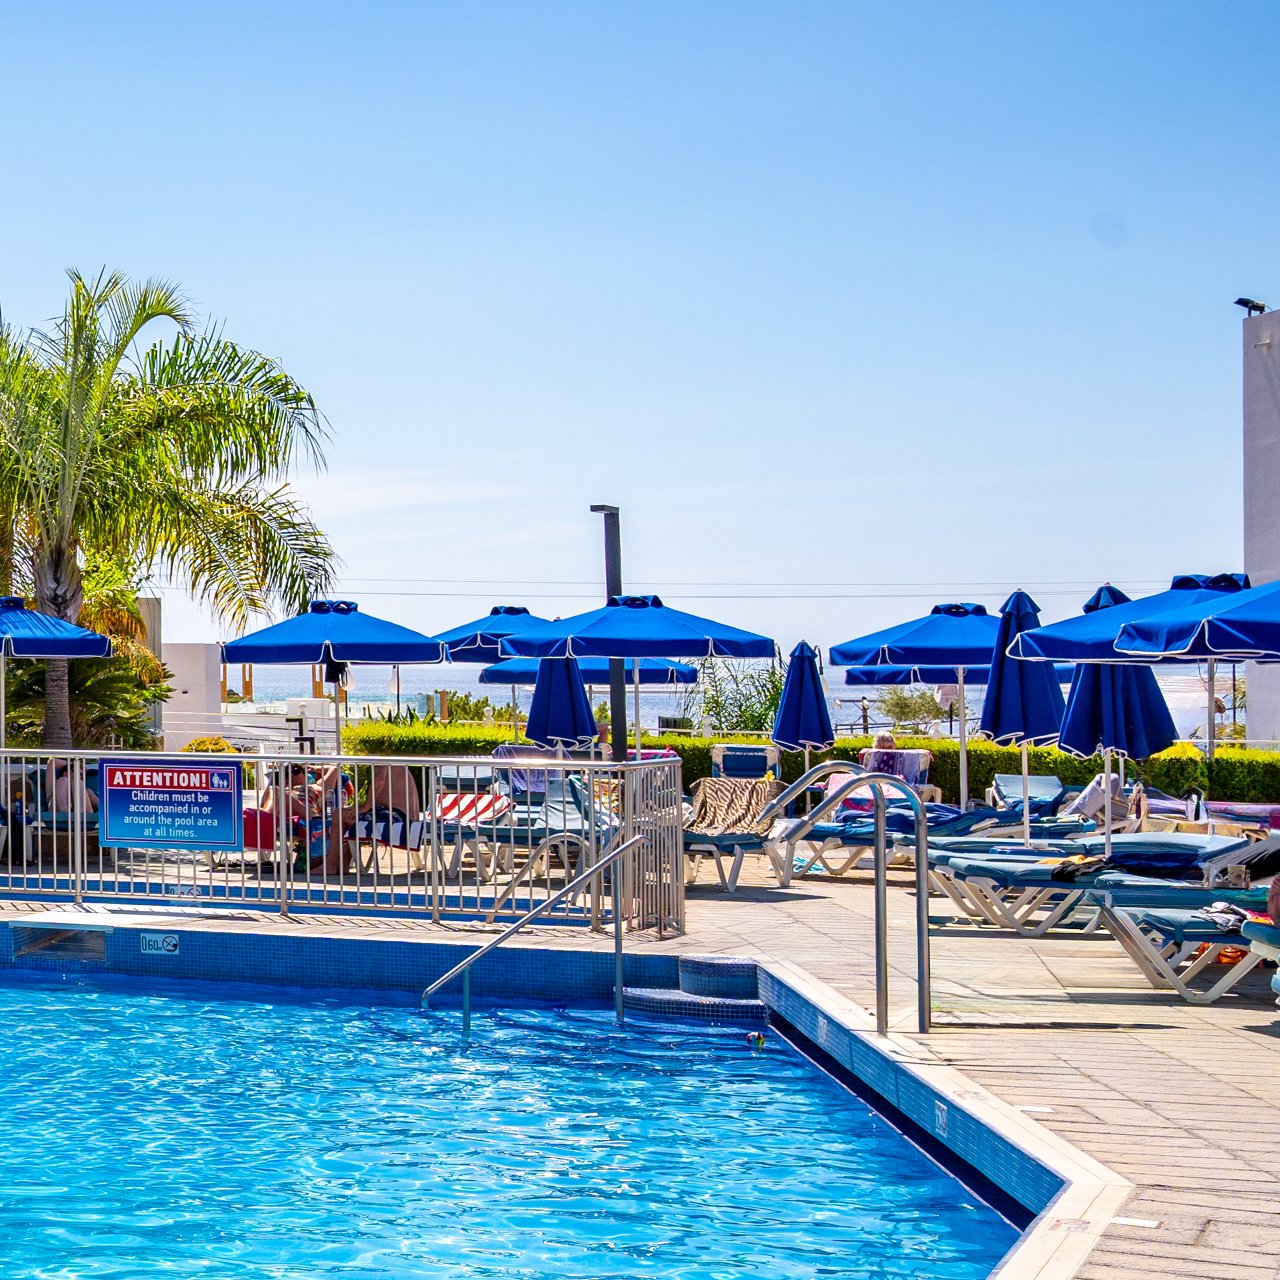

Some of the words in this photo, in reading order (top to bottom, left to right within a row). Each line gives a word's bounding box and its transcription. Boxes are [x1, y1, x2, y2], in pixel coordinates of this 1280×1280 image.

[113, 771, 206, 787] ATTENTION!
[131, 791, 170, 802] Children
[172, 793, 195, 802] must
[198, 792, 209, 802] be
[129, 803, 188, 816] accompanied
[191, 805, 199, 814] in
[202, 806, 212, 814] or
[124, 815, 155, 825] around
[158, 816, 172, 825] the
[174, 817, 195, 828] pool
[144, 828, 152, 836] at
[155, 827, 166, 836] all
[169, 828, 197, 838] times.
